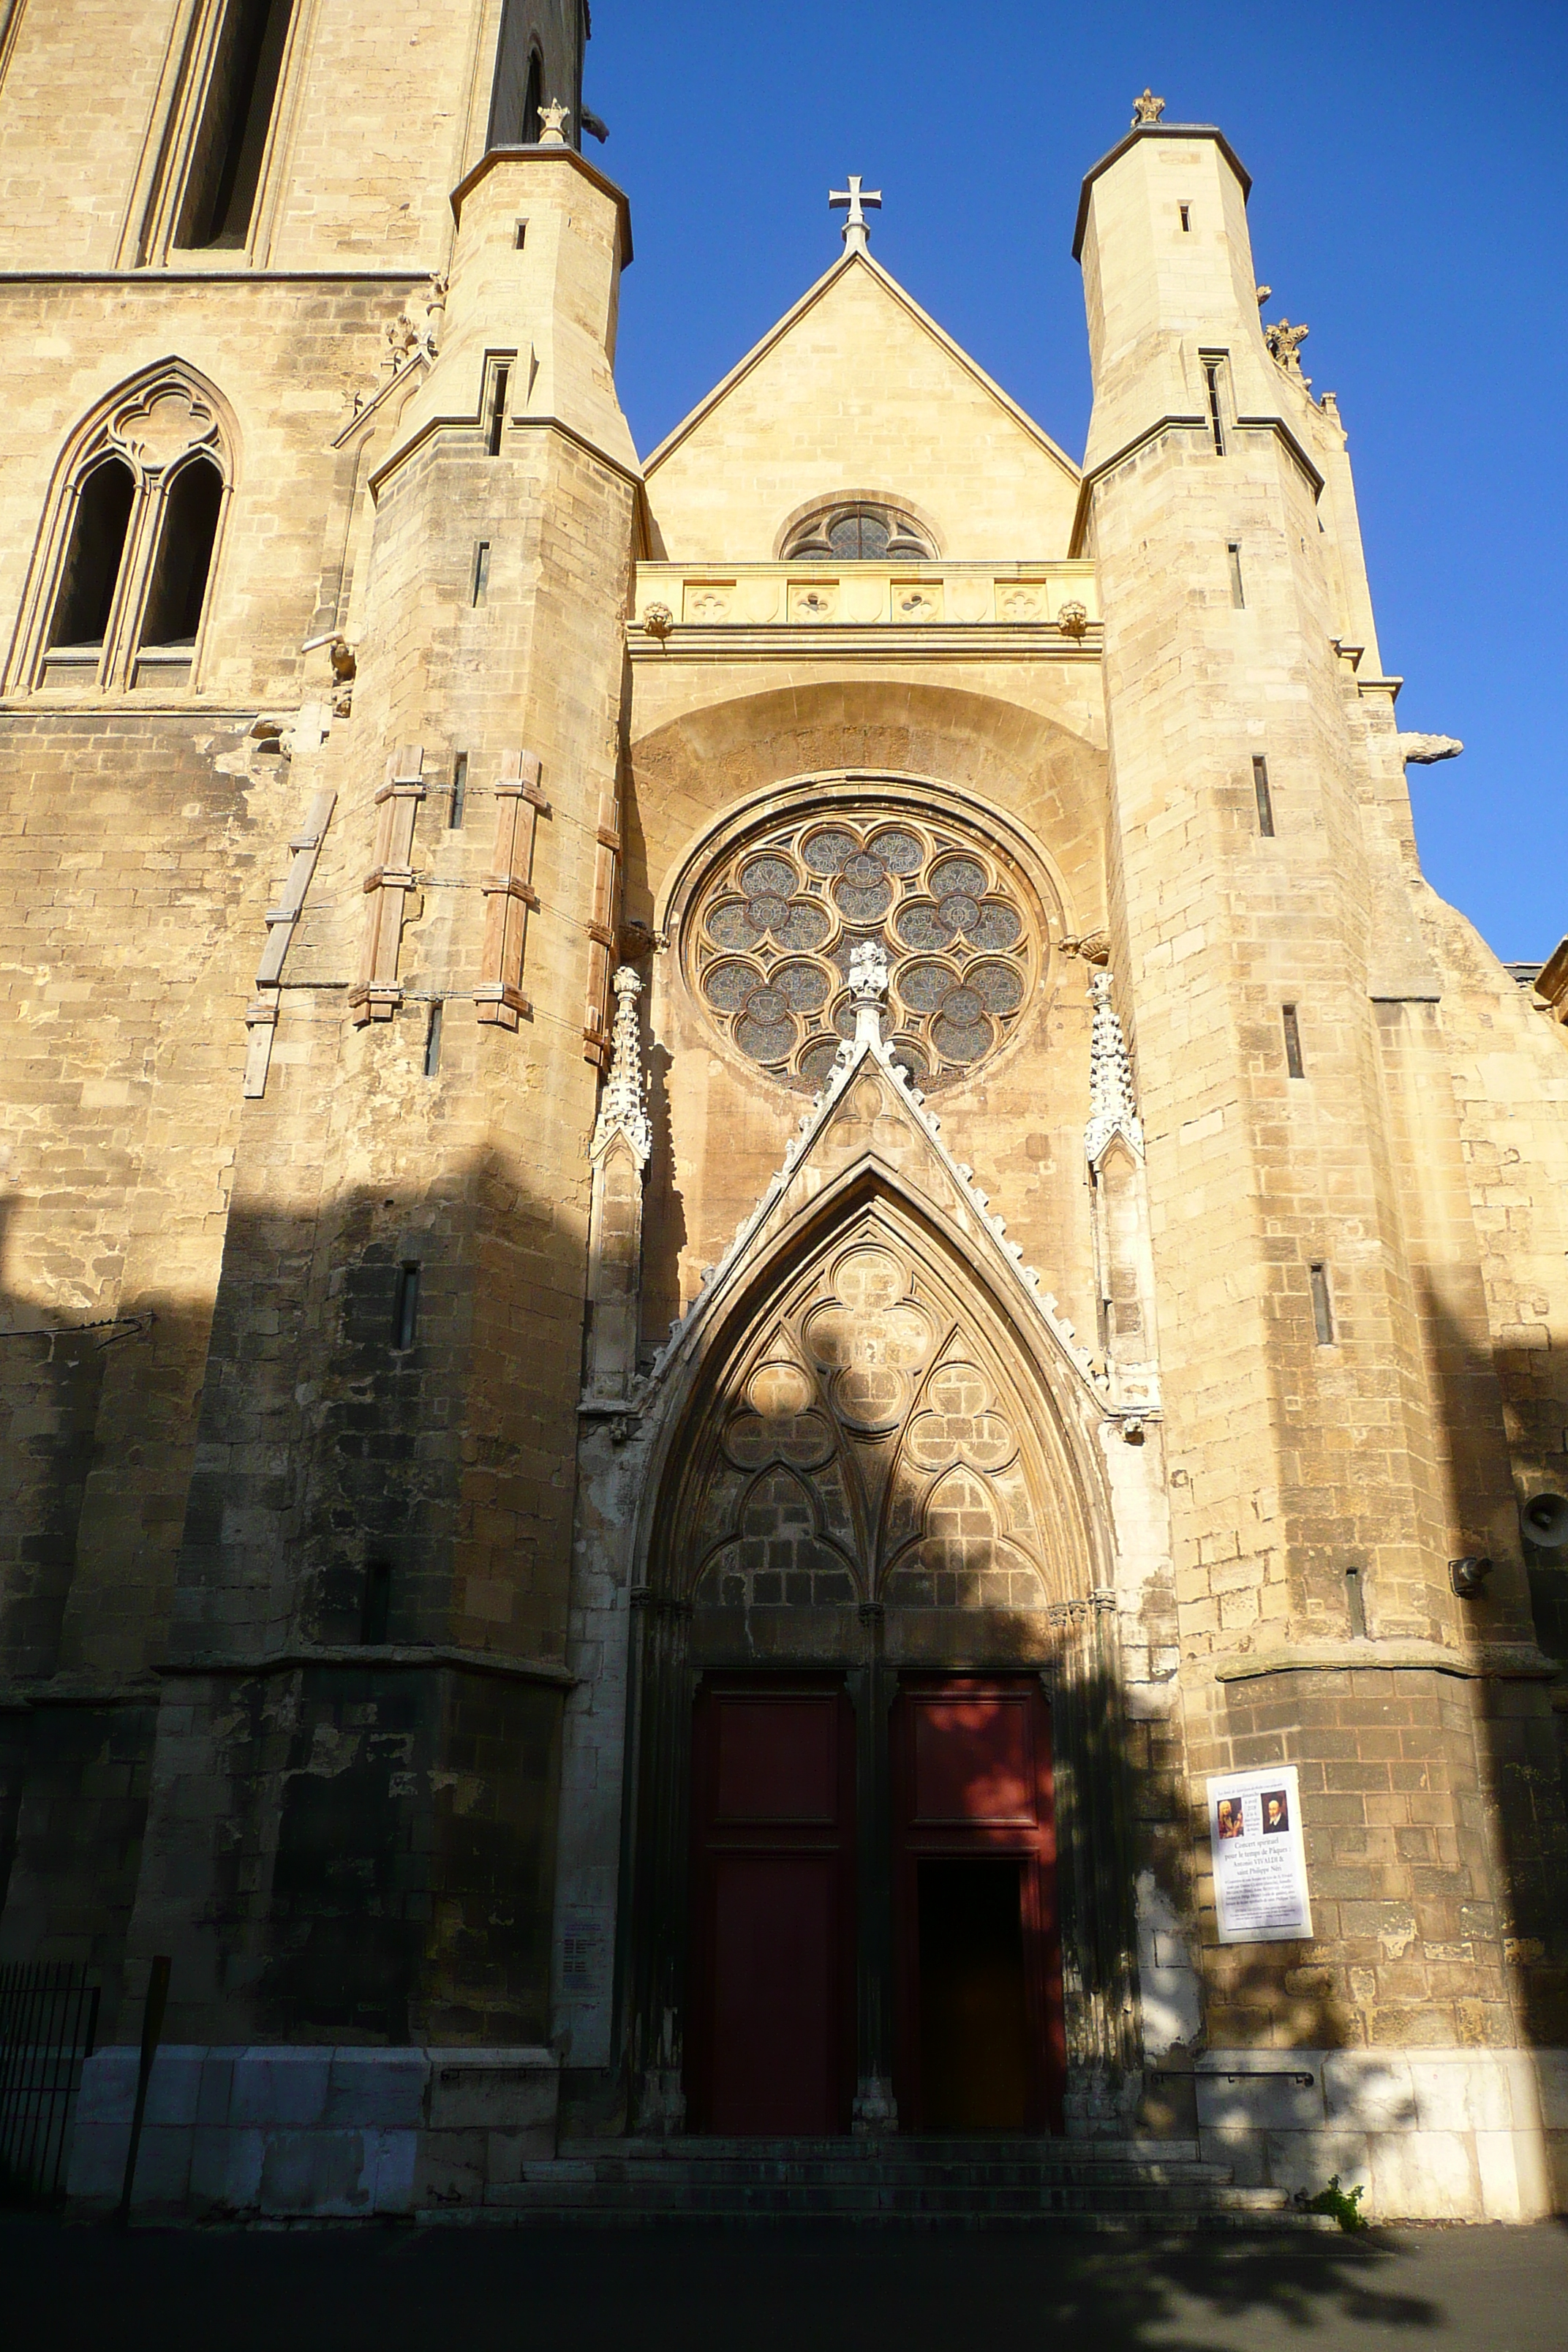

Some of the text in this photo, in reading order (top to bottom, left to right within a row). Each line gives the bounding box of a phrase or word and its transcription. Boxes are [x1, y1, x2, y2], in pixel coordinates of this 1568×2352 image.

[1235, 1836, 1279, 1849] Concert spirituel
[1224, 1853, 1237, 1861] pour
[1238, 1850, 1243, 1858] le
[1268, 1847, 1288, 1856] Pâques
[1234, 1859, 1253, 1867] Antonio
[1254, 1856, 1278, 1865] VIVALDI
[1249, 1866, 1270, 1875] Philippe
